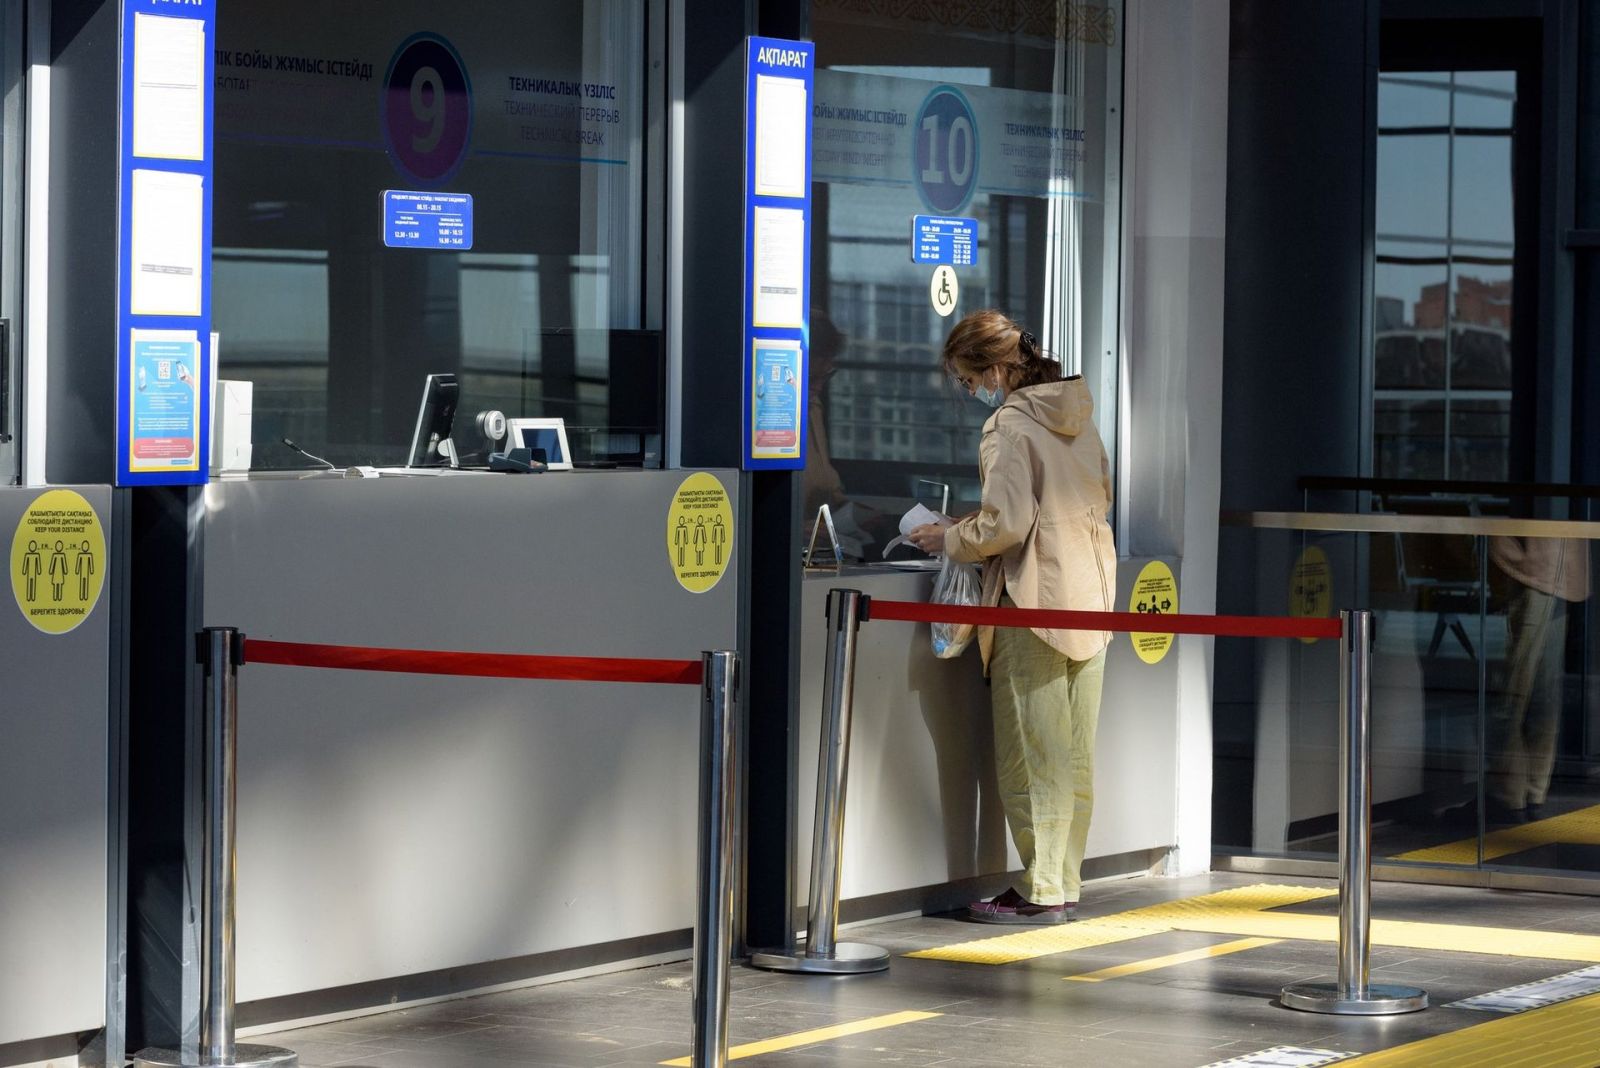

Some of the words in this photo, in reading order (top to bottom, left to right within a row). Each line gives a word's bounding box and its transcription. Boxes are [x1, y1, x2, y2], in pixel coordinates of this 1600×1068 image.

[235, 49, 273, 70] БОЙЫ
[275, 54, 324, 74] ЖҰМЫС
[326, 57, 373, 82] ІСТЕЙДІ
[757, 46, 808, 69] АҚПАРАТ
[509, 76, 582, 99] ТЕХНИКАЛЫҚ
[584, 83, 616, 100] ҮЗІЛІС
[409, 65, 446, 153] 9
[579, 106, 620, 124] ПЕРЕРЫВ
[576, 128, 604, 145] BREAK
[921, 114, 973, 186] 10
[30, 608, 57, 616] БЕРЕГИТЕ
[57, 608, 86, 616] ЗДОРОВЬЕ
